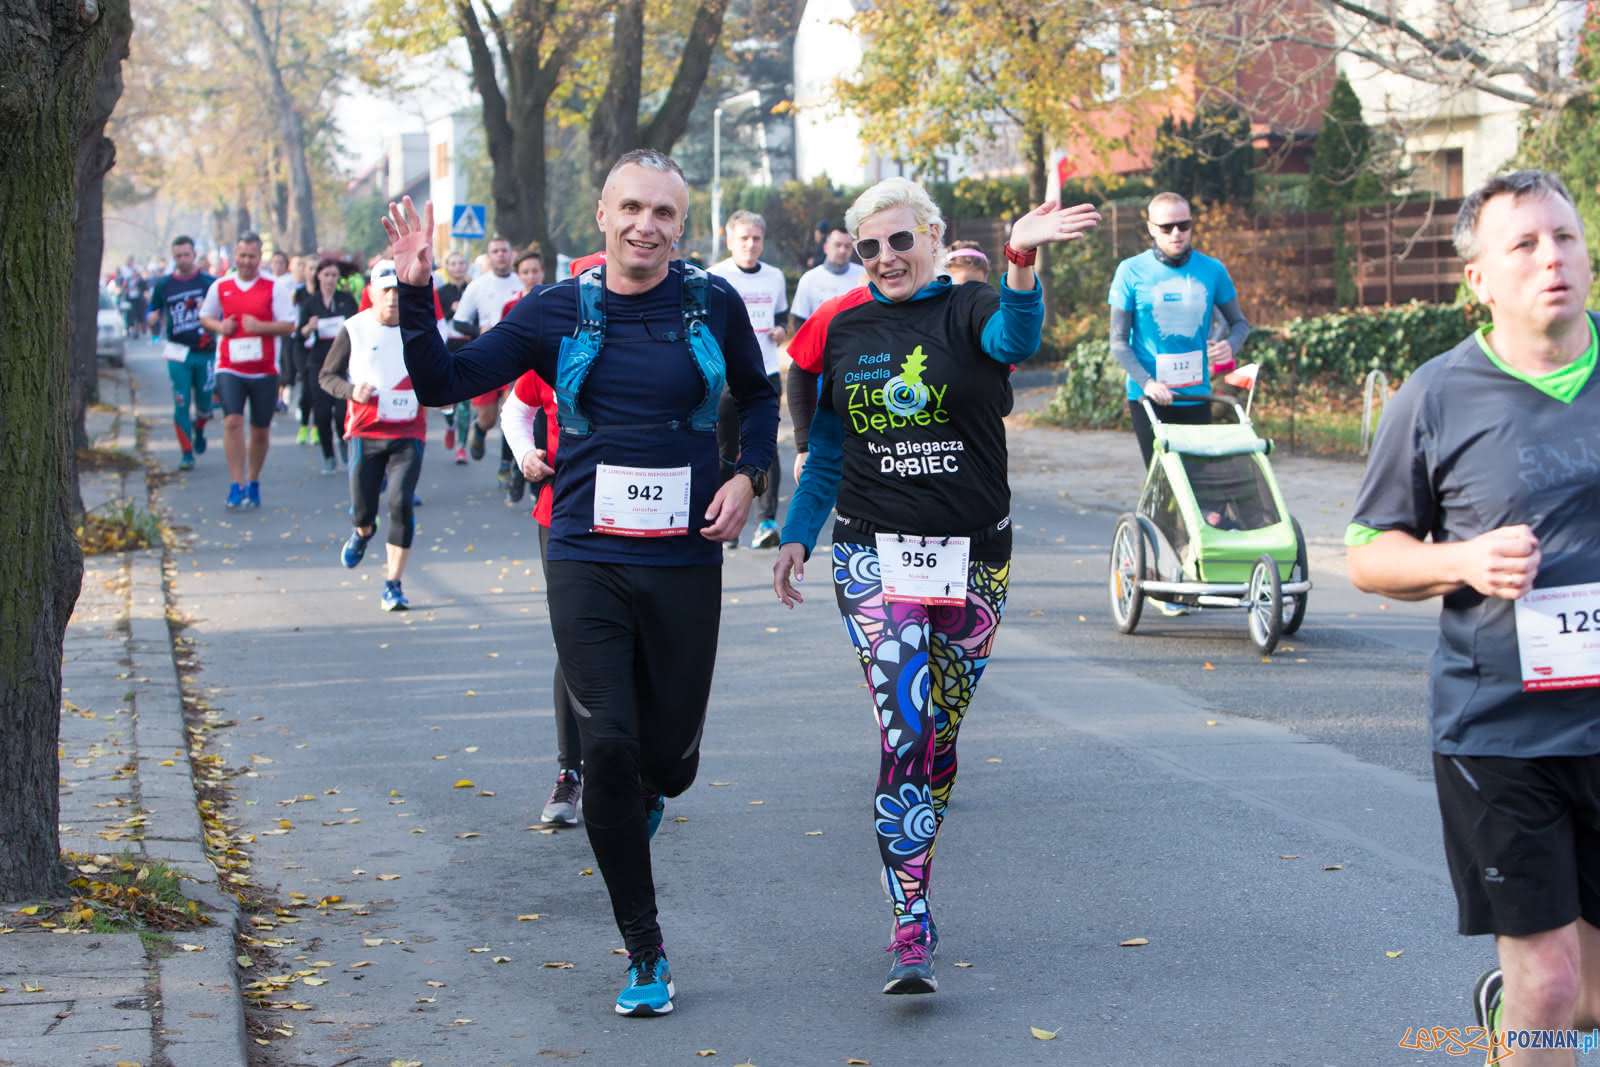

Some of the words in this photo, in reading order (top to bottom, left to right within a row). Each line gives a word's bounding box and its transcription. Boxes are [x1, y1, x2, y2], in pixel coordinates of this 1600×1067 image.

[858, 352, 891, 365] Rada
[844, 367, 891, 383] Osiedla
[849, 409, 950, 434] Dębiec
[895, 440, 964, 456] Biegacza
[627, 484, 663, 501] 942
[901, 551, 937, 568] 956
